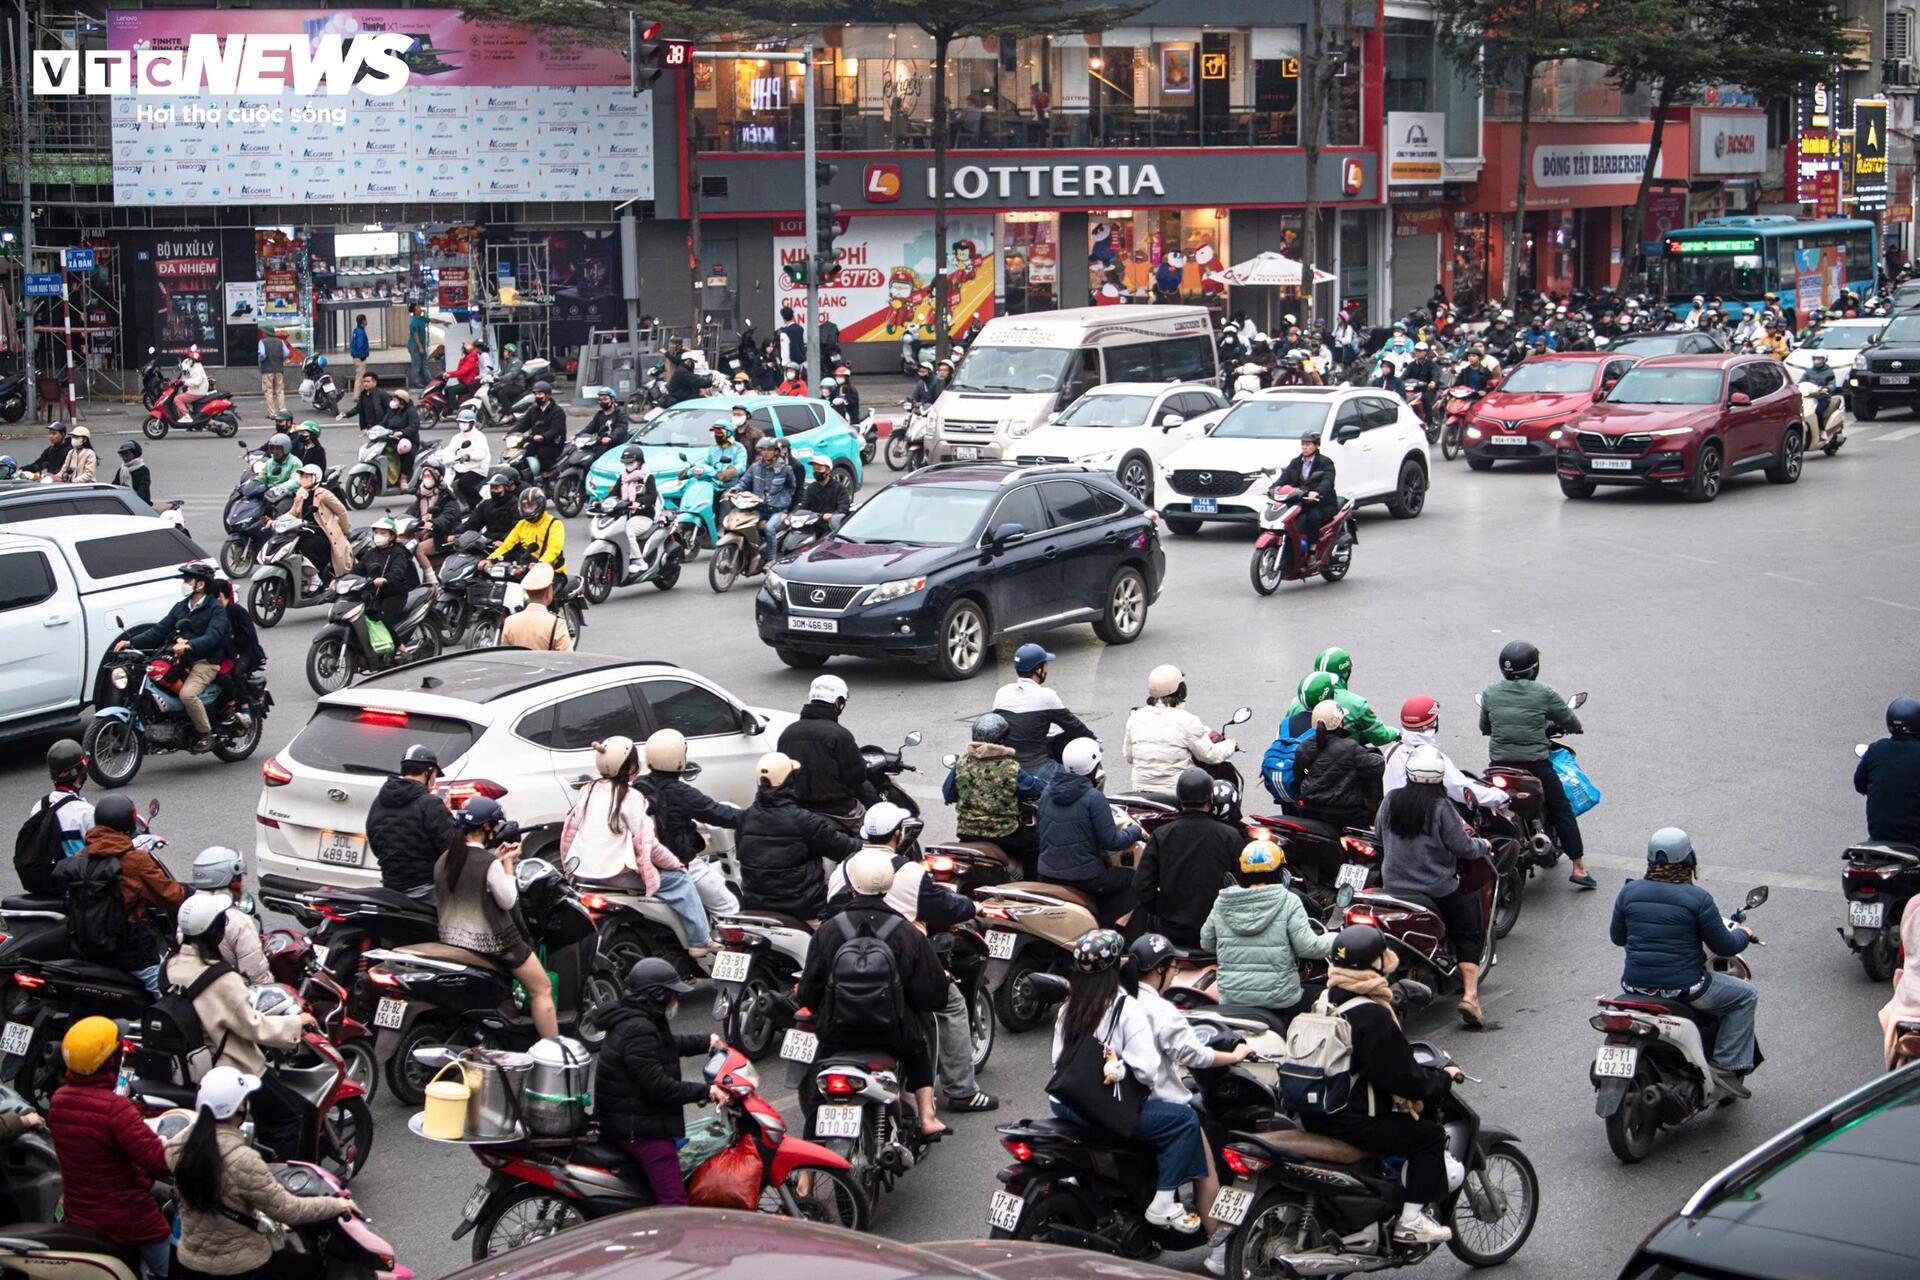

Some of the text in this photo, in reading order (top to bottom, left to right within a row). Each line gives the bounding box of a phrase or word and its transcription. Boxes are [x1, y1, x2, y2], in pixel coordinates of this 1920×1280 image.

[1543, 151, 1648, 177] ĐÔNG TÂY BARBERSHO
[926, 164, 1165, 199] LOTTERIA
[157, 240, 214, 259] BỘ VI XỬ LÝ
[160, 261, 217, 276] ĐA NHIỆM
[792, 619, 833, 631] 30M-466.98
[333, 834, 351, 849] 30L
[323, 849, 358, 863] 489.98
[720, 953, 745, 965] 29-B1
[381, 1000, 402, 1014] 29-B2
[8, 1024, 29, 1037] 19-B1
[782, 1045, 812, 1061] 097.56
[1602, 1048, 1630, 1060] 29-Y1
[1598, 1062, 1633, 1076] 492.39
[824, 1107, 855, 1121] 90-B5
[819, 1121, 858, 1135] 010.07
[996, 1192, 1019, 1213] 17-AC
[1220, 1189, 1247, 1206] 35-B1
[989, 1208, 1018, 1231] 044.65
[1211, 1203, 1244, 1223] 943.77
